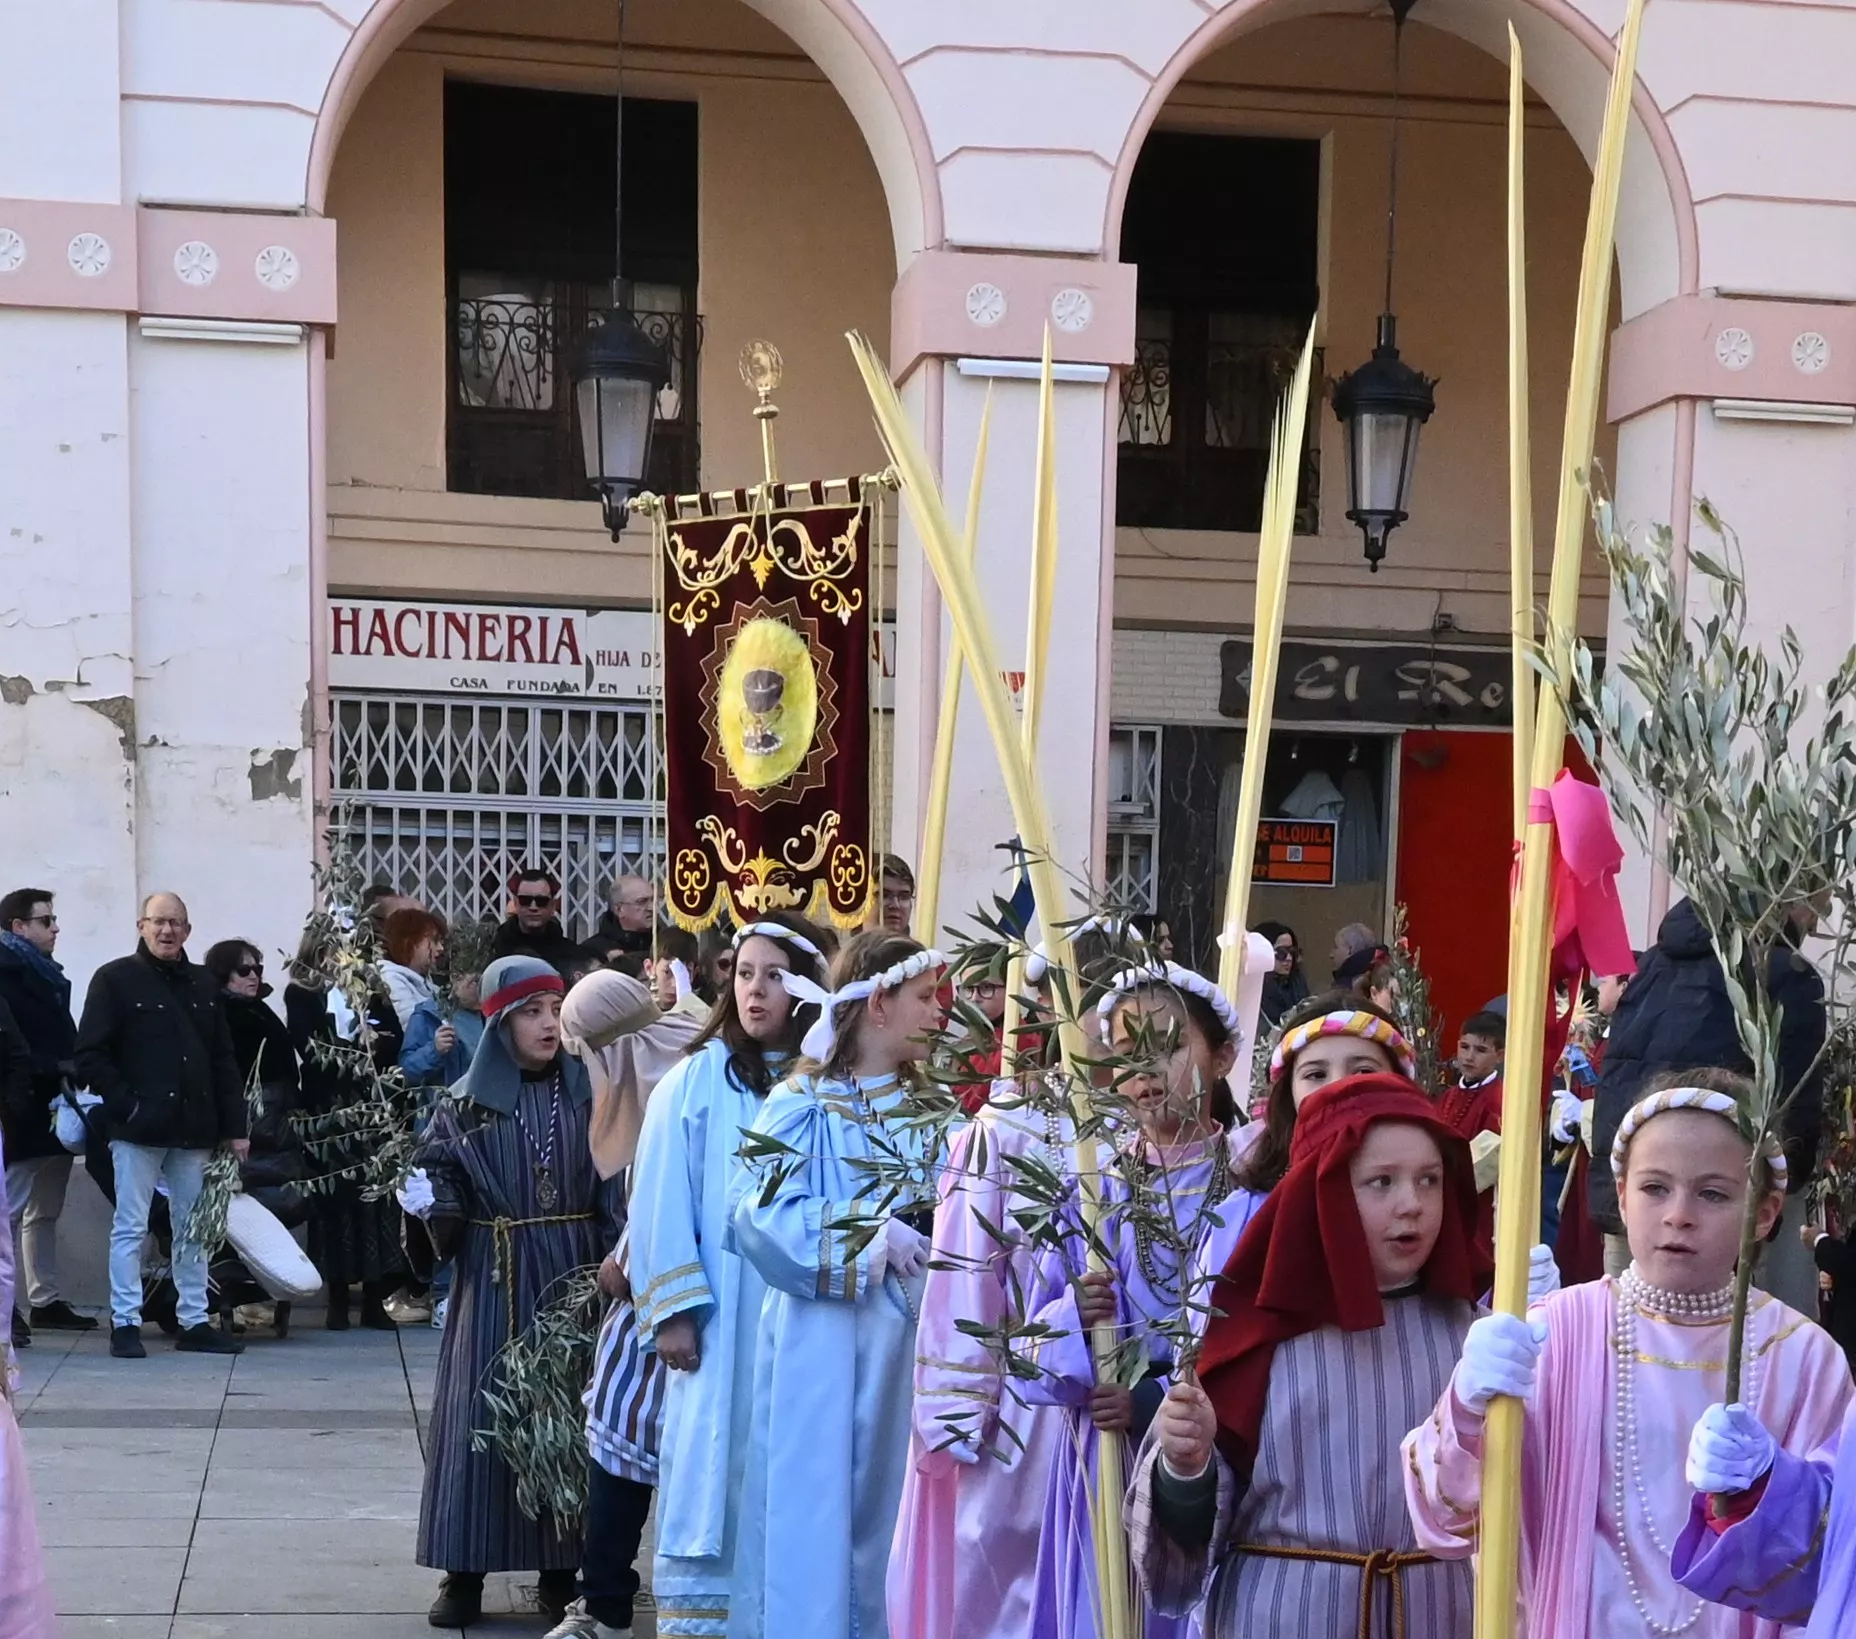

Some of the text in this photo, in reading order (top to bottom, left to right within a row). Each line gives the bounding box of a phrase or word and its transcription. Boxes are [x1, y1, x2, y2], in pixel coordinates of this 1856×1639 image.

[331, 606, 582, 666] HACINERIA
[595, 649, 631, 667] HIJA
[450, 676, 488, 690] CASA
[598, 682, 618, 694] EN
[637, 684, 663, 696] 1.87
[1294, 655, 1361, 701] El
[1274, 824, 1332, 843] ALQUILA
